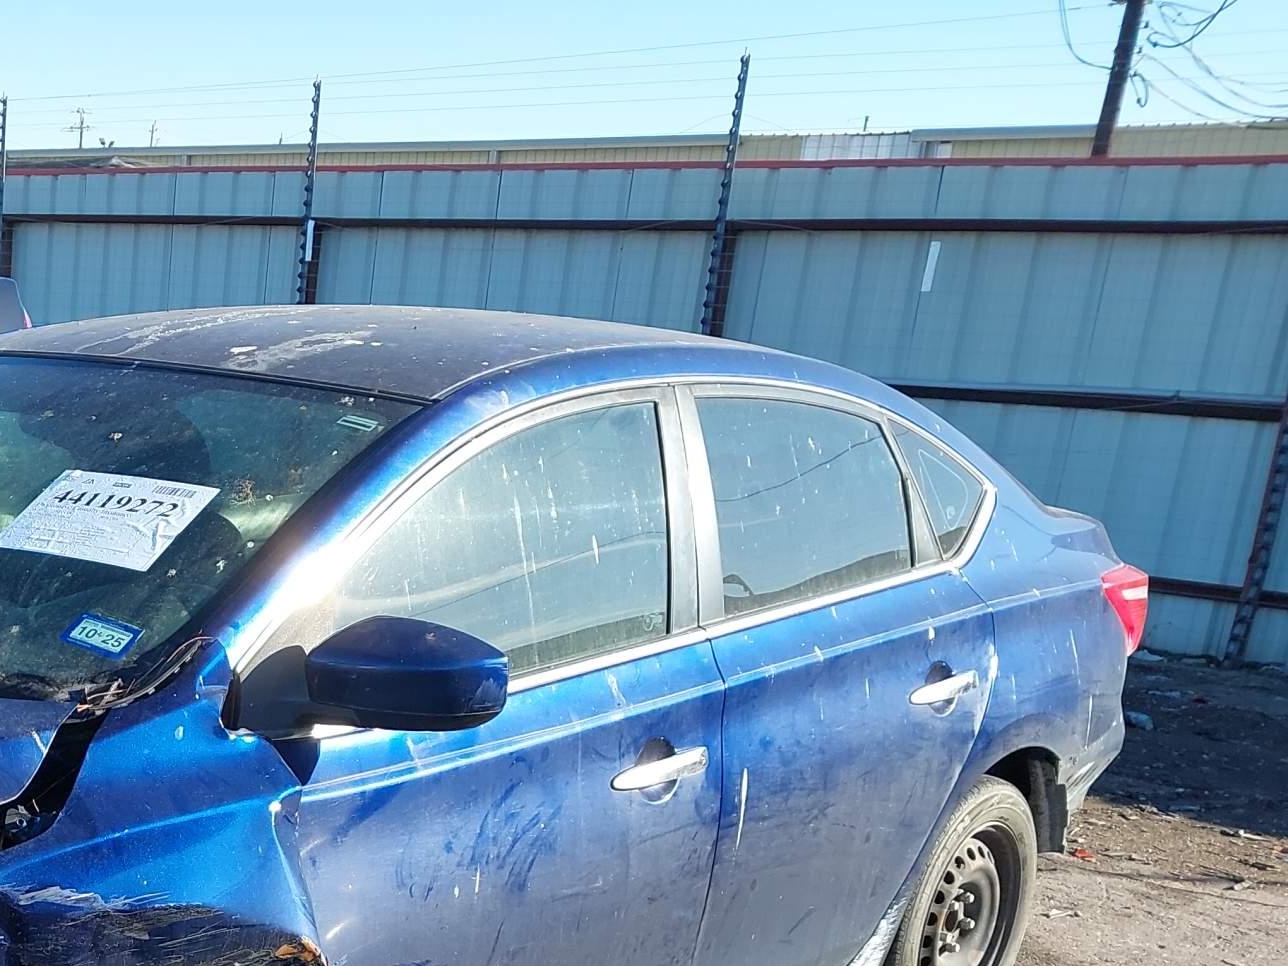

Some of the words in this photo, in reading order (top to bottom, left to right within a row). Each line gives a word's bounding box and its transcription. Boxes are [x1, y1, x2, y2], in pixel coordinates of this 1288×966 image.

[53, 489, 179, 518] 44119272
[78, 626, 98, 639] 10
[100, 634, 126, 648] 25
